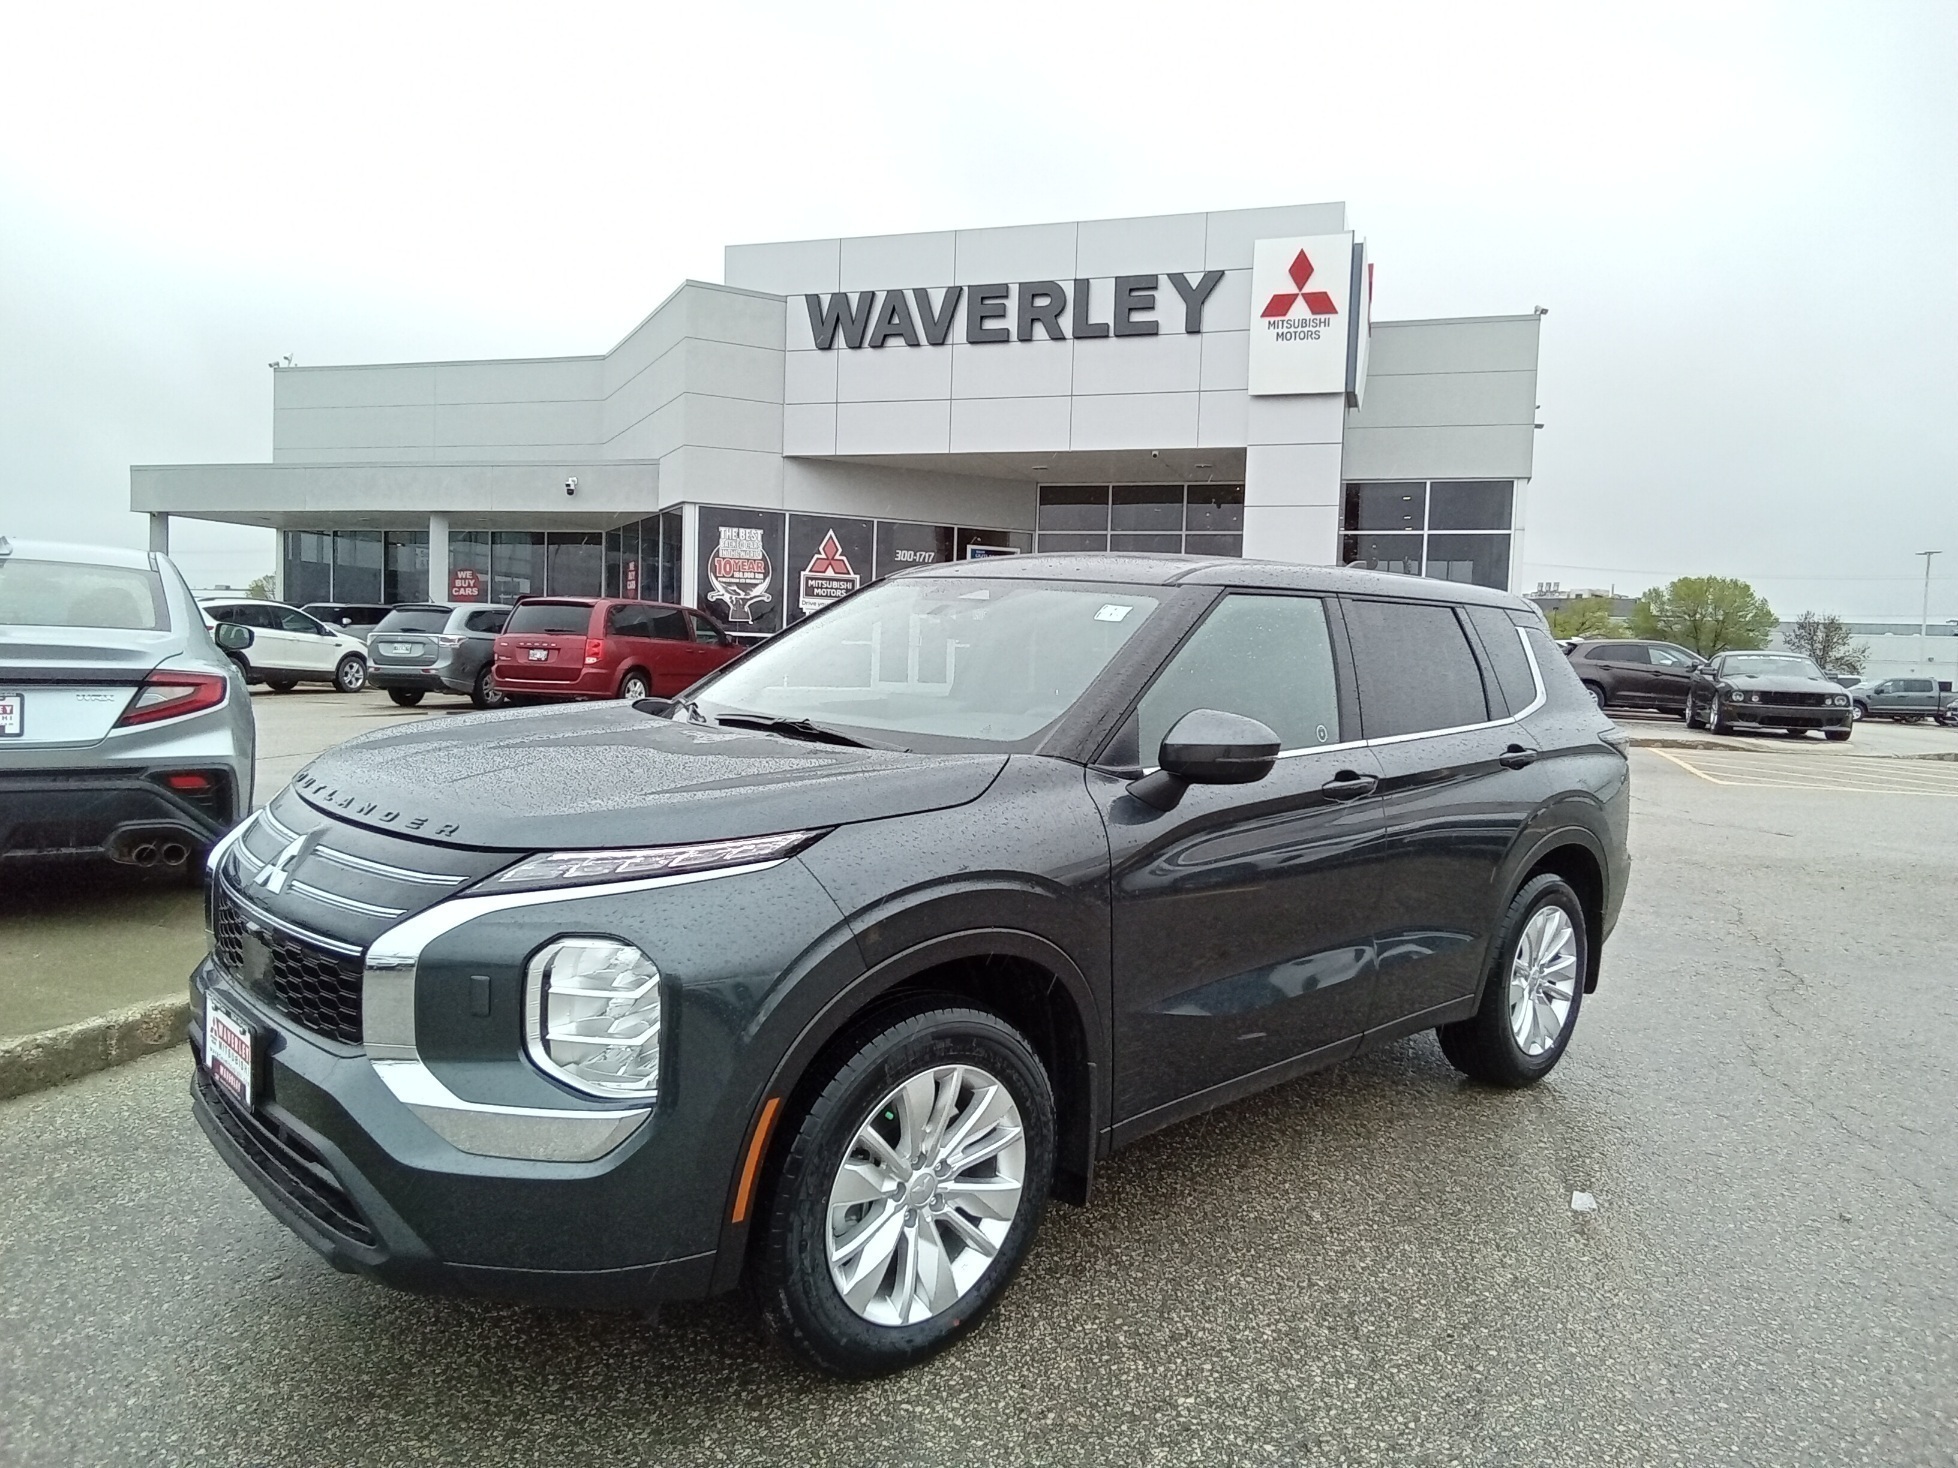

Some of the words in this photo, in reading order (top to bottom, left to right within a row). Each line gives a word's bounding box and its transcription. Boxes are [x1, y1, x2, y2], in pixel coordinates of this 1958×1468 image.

[805, 270, 1225, 350] WAVERLEY
[1267, 317, 1331, 330] MITSUBISHI
[1276, 330, 1321, 342] MOTORS
[719, 526, 738, 540] THE
[739, 528, 763, 540] BEST
[894, 550, 935, 562] 300-1717
[715, 558, 733, 577] 10
[733, 559, 764, 572] YEAR
[457, 571, 473, 579] WE
[455, 579, 475, 587] BUY
[808, 580, 853, 589] MITSUBISHI
[452, 587, 479, 596] CARS
[813, 588, 847, 597] MOTORS
